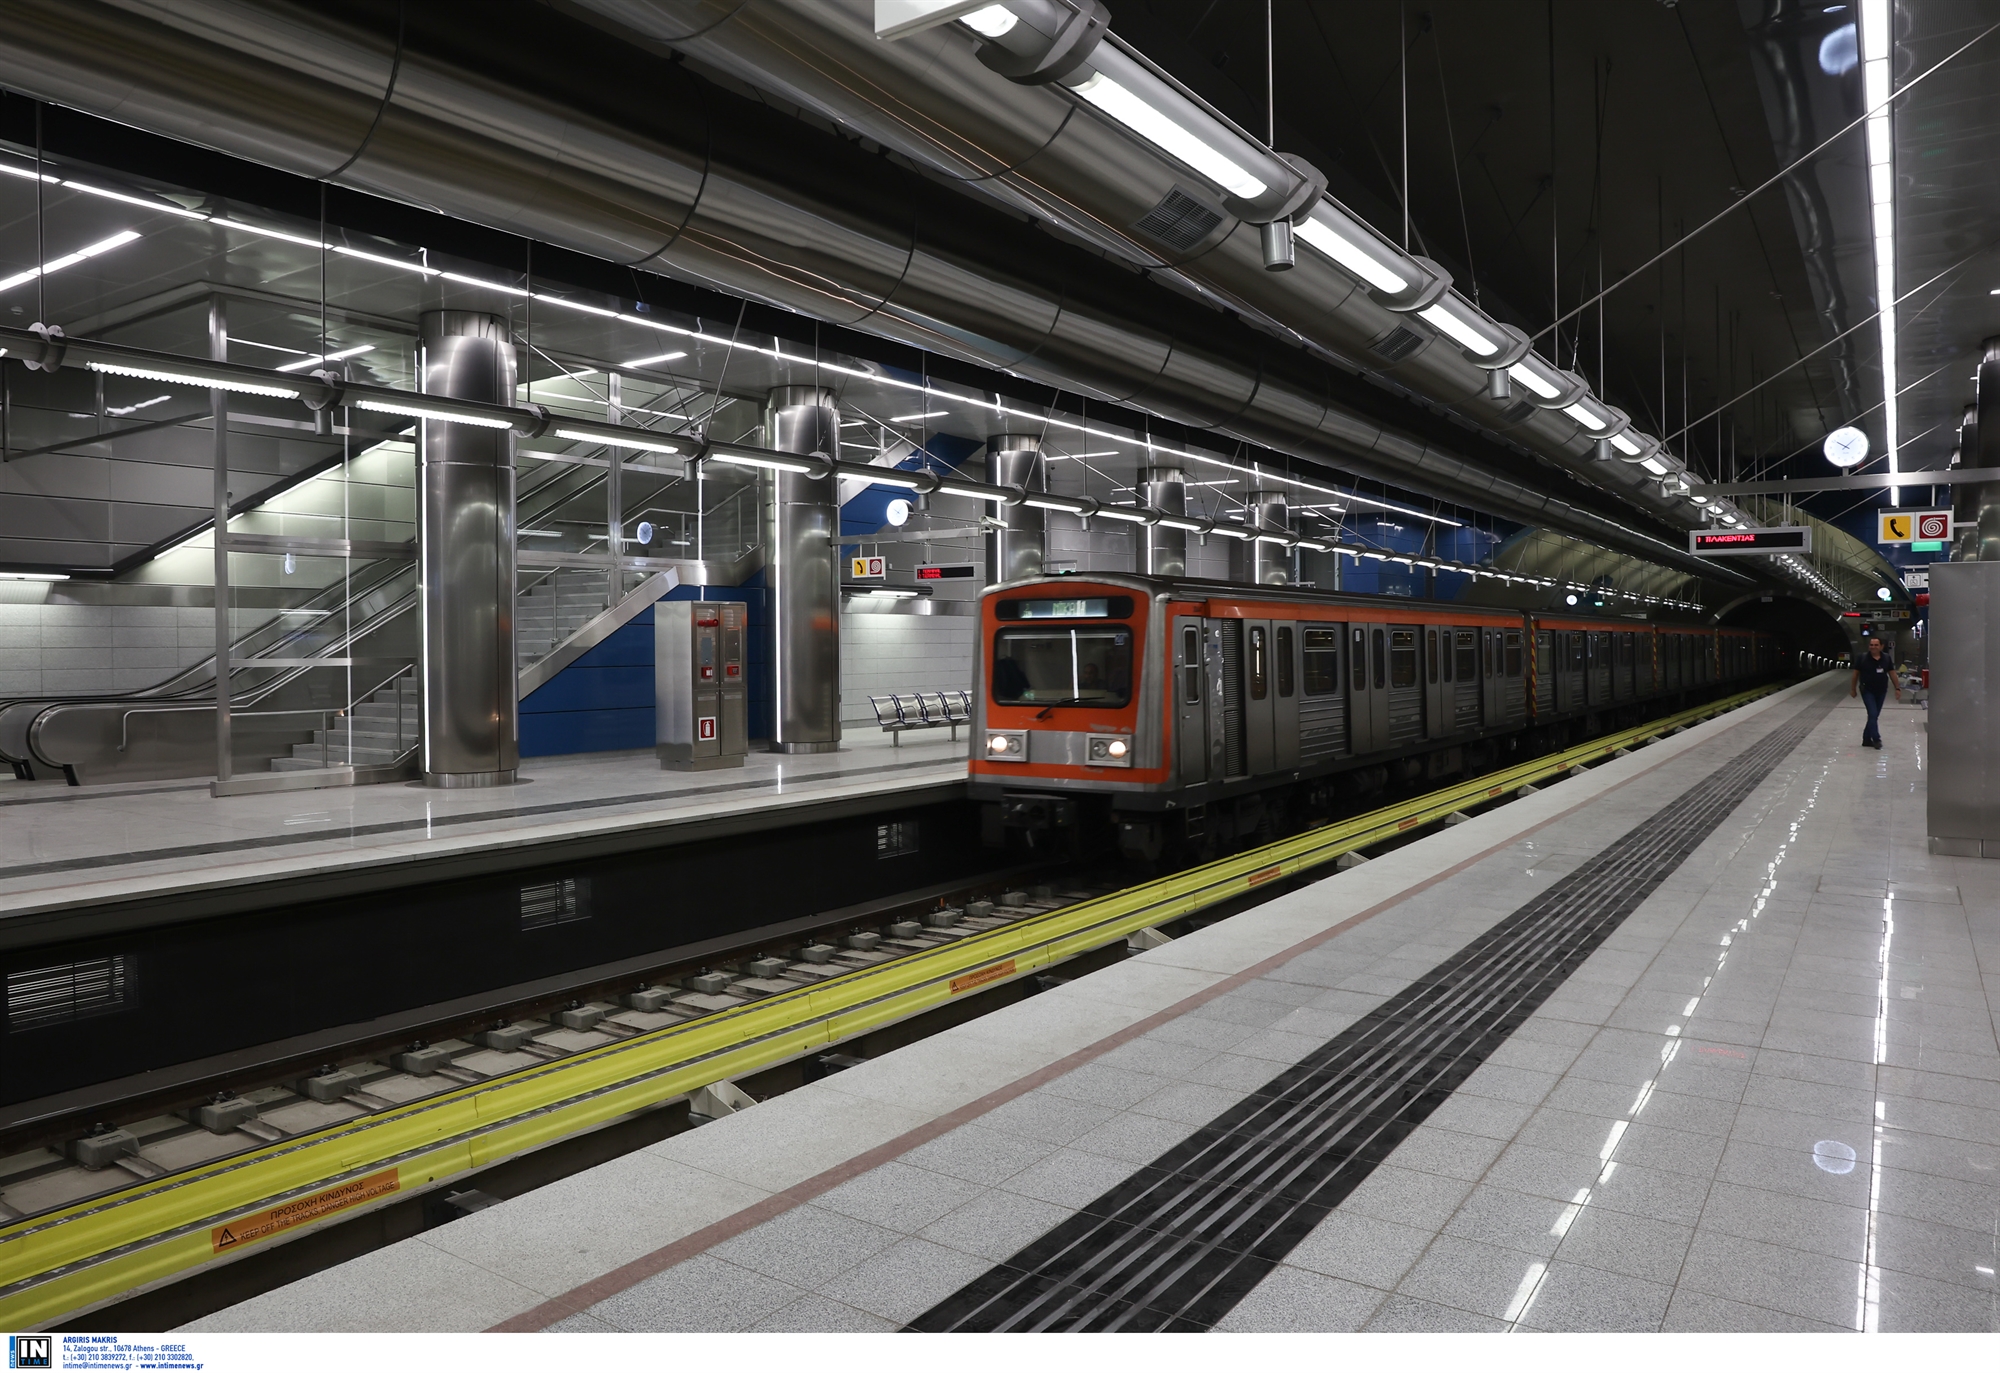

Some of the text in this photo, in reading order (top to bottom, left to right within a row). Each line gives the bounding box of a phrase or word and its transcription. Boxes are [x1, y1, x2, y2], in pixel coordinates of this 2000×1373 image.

[1705, 534, 1755, 543] ΠΛΑΚΕΝΤΙΑΣ
[240, 1227, 260, 1240] KEEP
[261, 1221, 275, 1234] OFF
[277, 1216, 291, 1228] THE
[321, 1198, 349, 1213] DANGER
[349, 1193, 366, 1205] HIGH
[365, 1180, 395, 1197] VOLTAGE
[270, 1182, 365, 1220] ΠΡΟΣΟΧΗ ΚΙΝΔΥΝΟΣ
